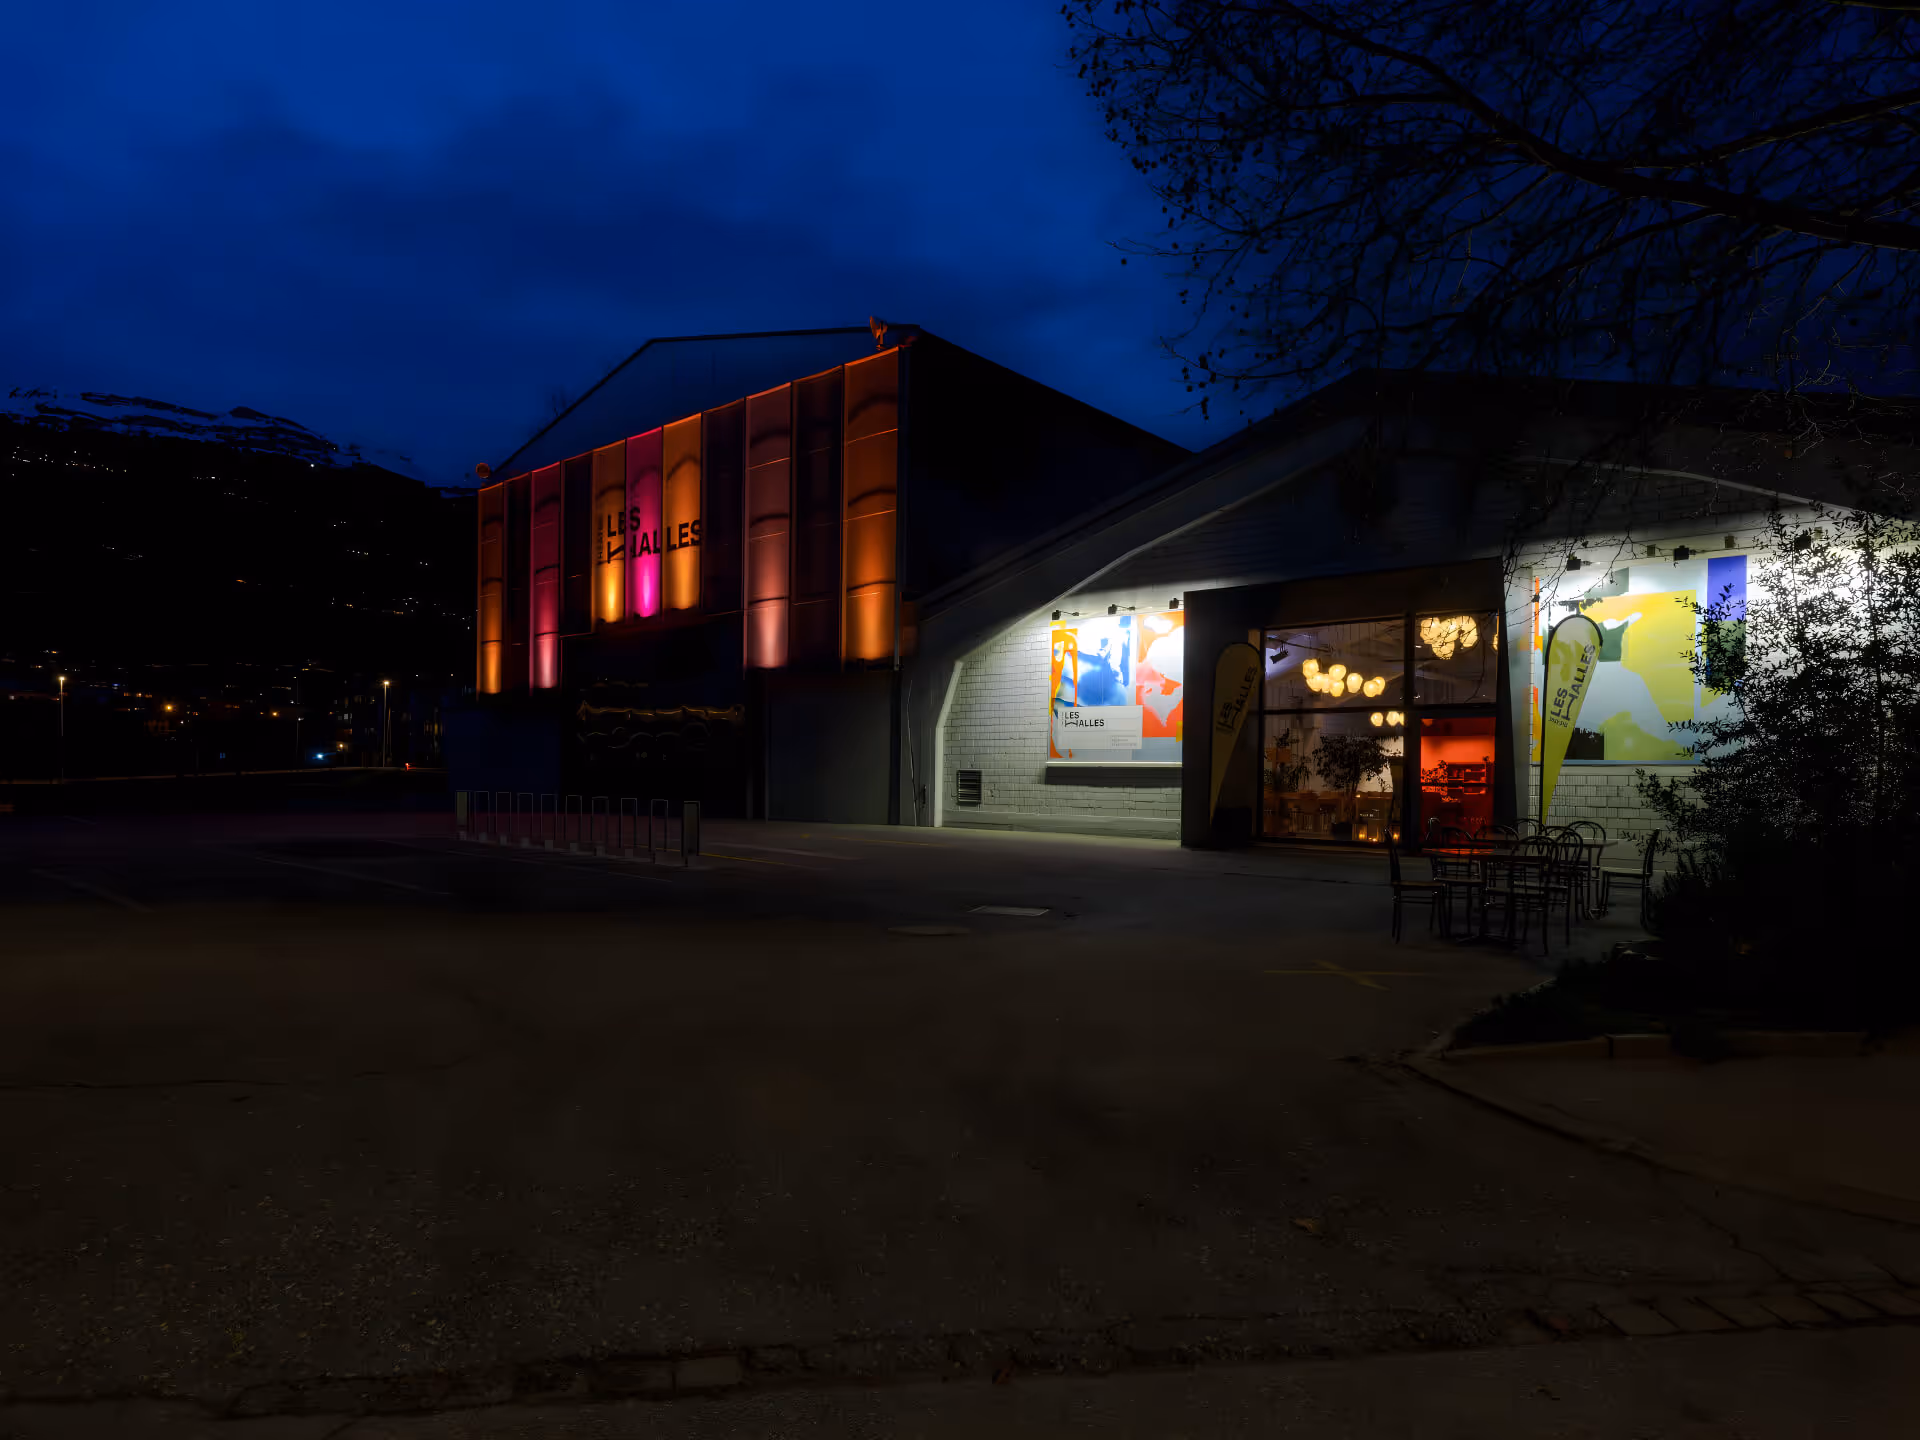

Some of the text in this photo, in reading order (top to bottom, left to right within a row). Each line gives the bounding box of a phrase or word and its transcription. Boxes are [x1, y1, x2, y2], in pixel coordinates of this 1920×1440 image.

[607, 506, 641, 538] LES
[607, 519, 703, 564] HALLES
[1561, 644, 1596, 721] HALLES
[1064, 711, 1080, 719] LES
[1550, 686, 1569, 718] LES
[1064, 719, 1105, 728] HALLES
